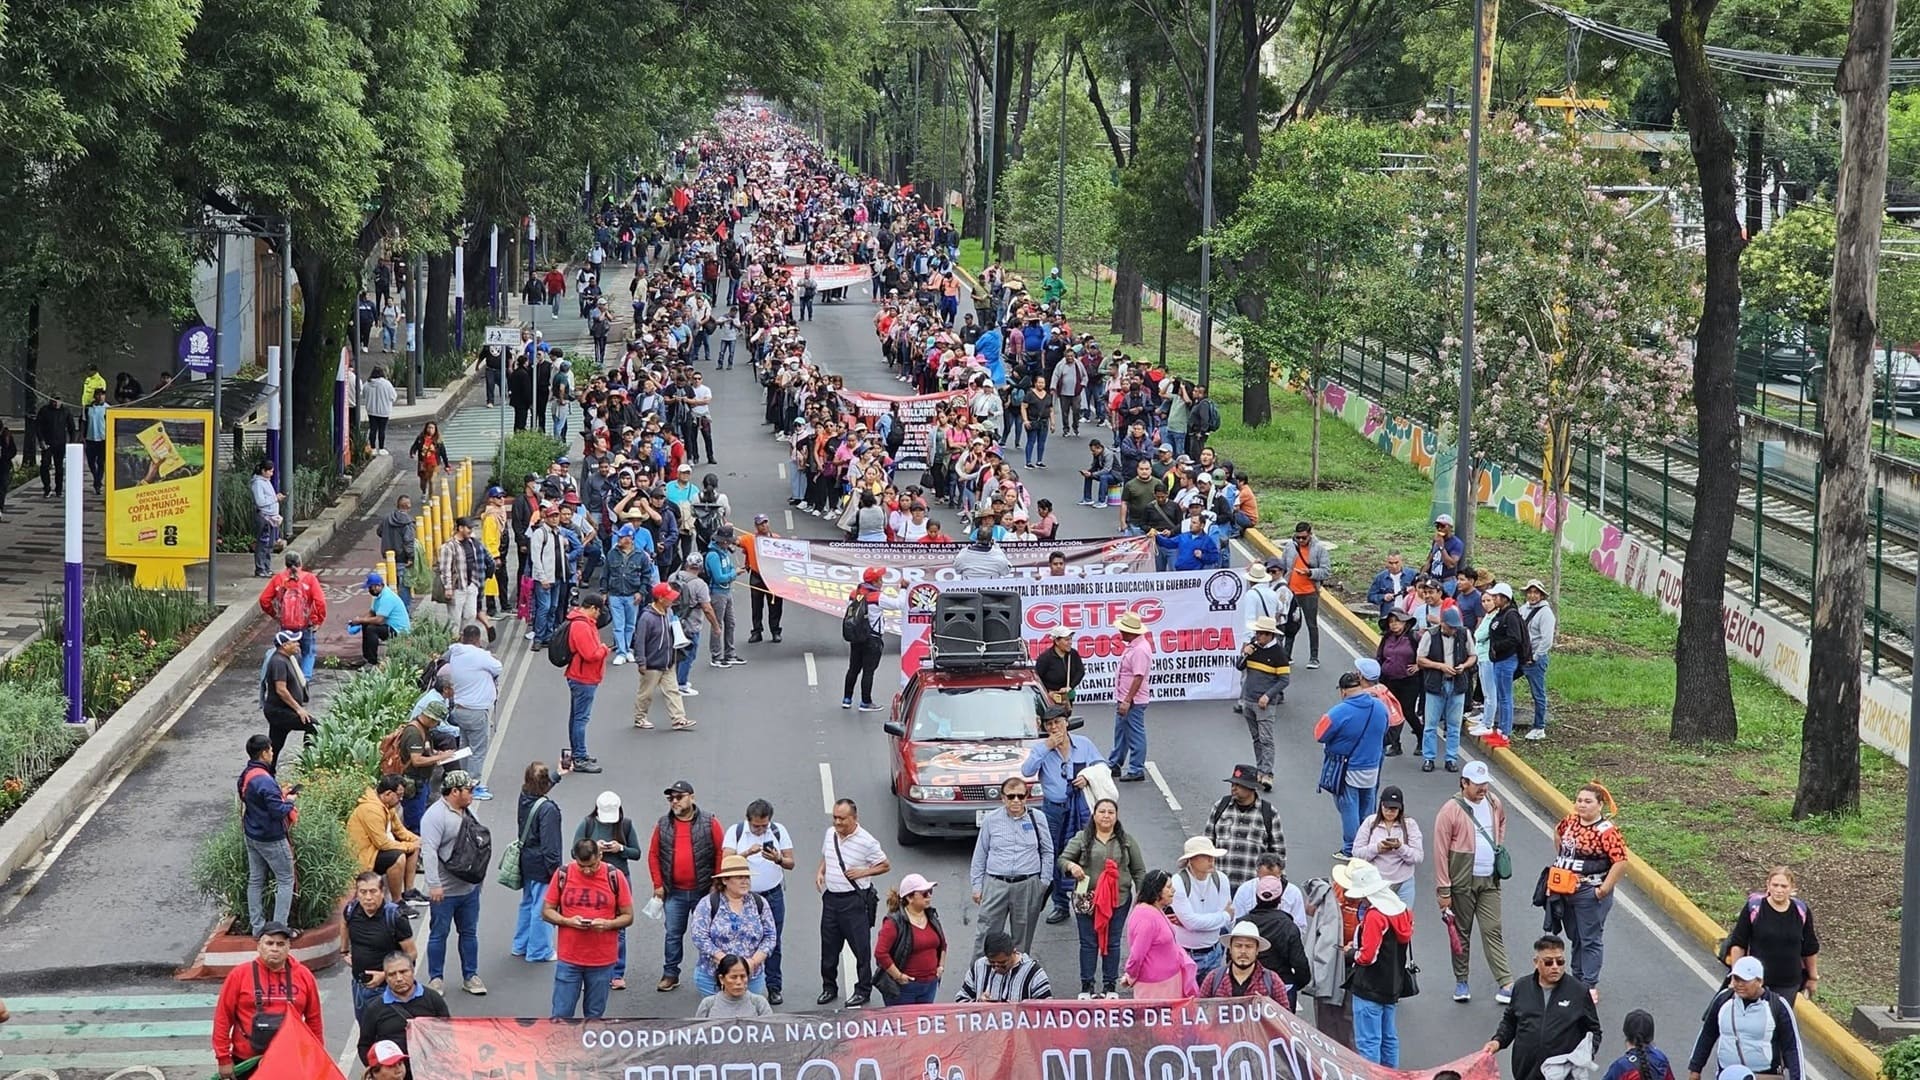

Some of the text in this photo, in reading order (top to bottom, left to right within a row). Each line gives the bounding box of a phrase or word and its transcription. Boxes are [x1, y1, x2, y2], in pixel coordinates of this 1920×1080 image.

[136, 485, 180, 499] PATROCINADOR
[128, 496, 190, 514] COPA MUNDIAL
[131, 514, 143, 523] DE
[144, 511, 155, 520] LA
[156, 508, 174, 519] FIFA
[829, 541, 890, 549] COORDINADORA
[1031, 584, 1039, 597] DE
[1041, 582, 1093, 596] TRABAJADORES
[1095, 582, 1104, 594] DE
[1105, 582, 1114, 593] LA
[1114, 579, 1155, 593] EDUCACIÓN
[1156, 580, 1165, 591] EN
[1166, 578, 1201, 591] GUERRERO
[1159, 627, 1236, 654] CHICA
[1176, 657, 1186, 669] SE
[1774, 641, 1800, 684] CAPITAL
[1157, 687, 1186, 698] CHICA
[1552, 872, 1561, 884] B
[582, 1024, 776, 1048] COORDINADORA
[785, 1019, 908, 1042] NACIONAL
[917, 1014, 946, 1035] DE
[955, 1008, 1135, 1033] TRABAJADORES
[1144, 1008, 1172, 1027] DE
[1181, 1007, 1209, 1026] LA
